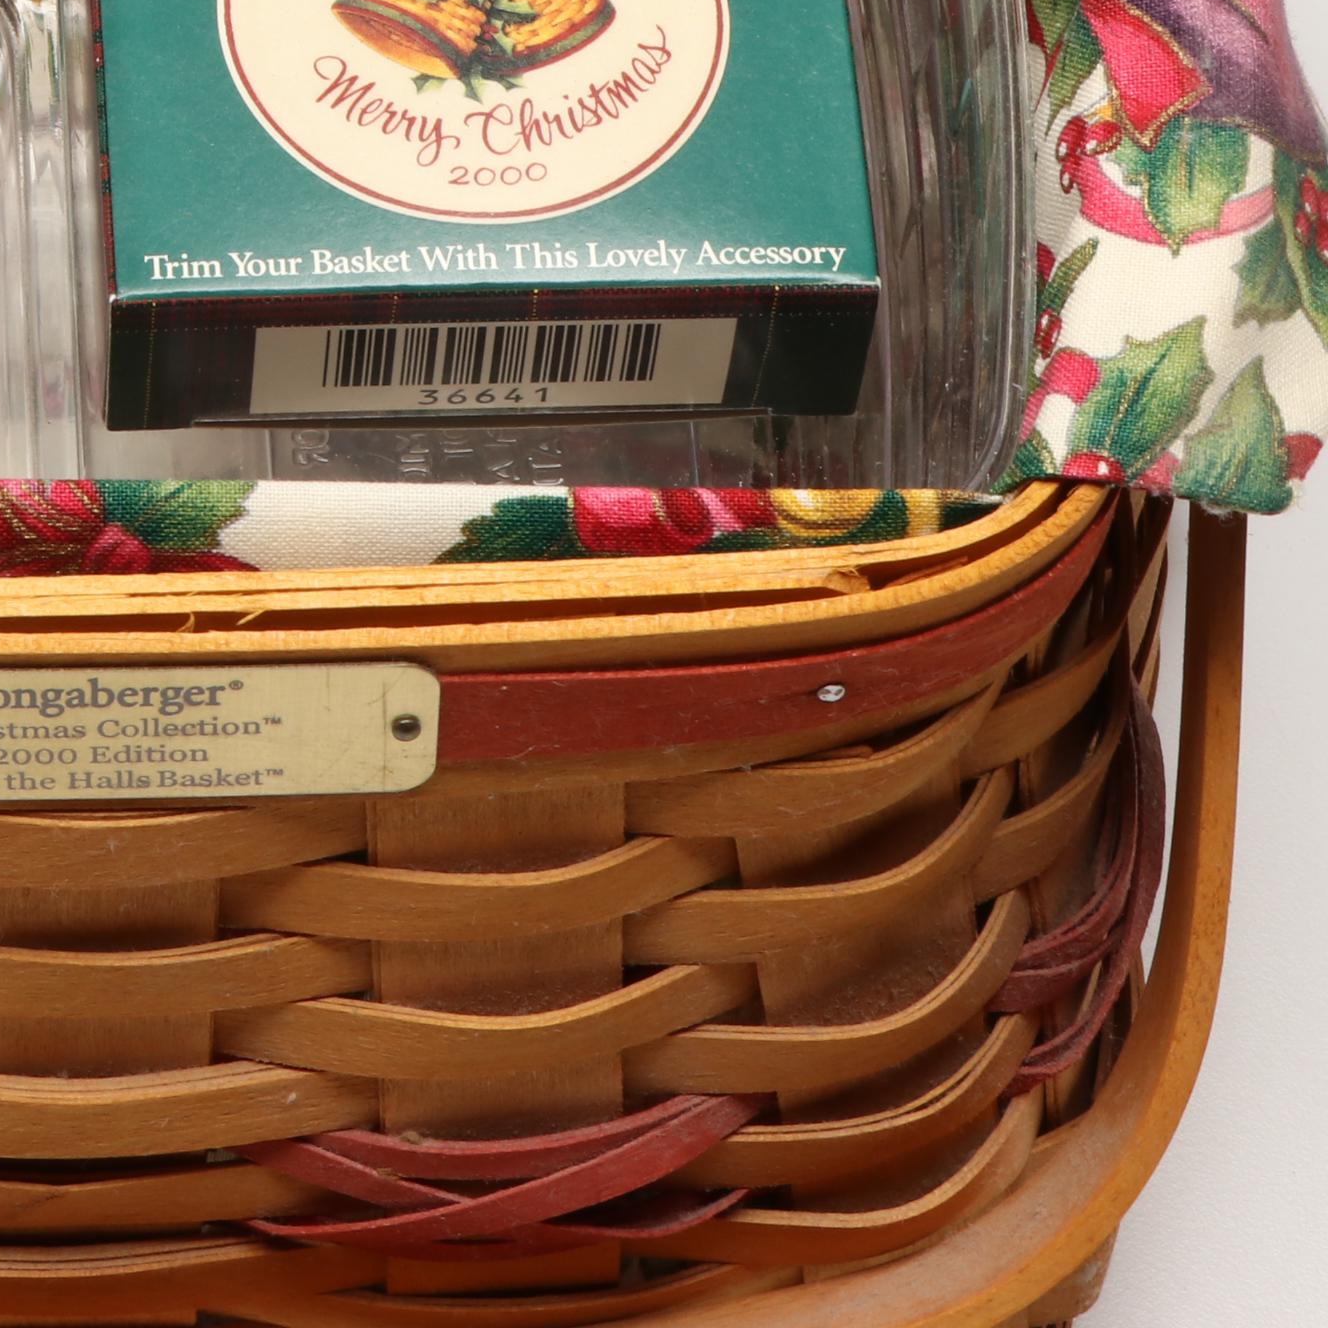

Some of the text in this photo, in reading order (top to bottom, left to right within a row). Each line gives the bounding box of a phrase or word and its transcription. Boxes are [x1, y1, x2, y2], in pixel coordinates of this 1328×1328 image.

[313, 24, 673, 167] Merry Christmas
[447, 162, 548, 186] 2000
[144, 239, 847, 280] Trim Your Basket With This Lovely Accessory
[417, 386, 550, 406] 36641
[89, 743, 210, 764] Edition
[3, 771, 57, 791] the
[67, 769, 152, 790] Halls
